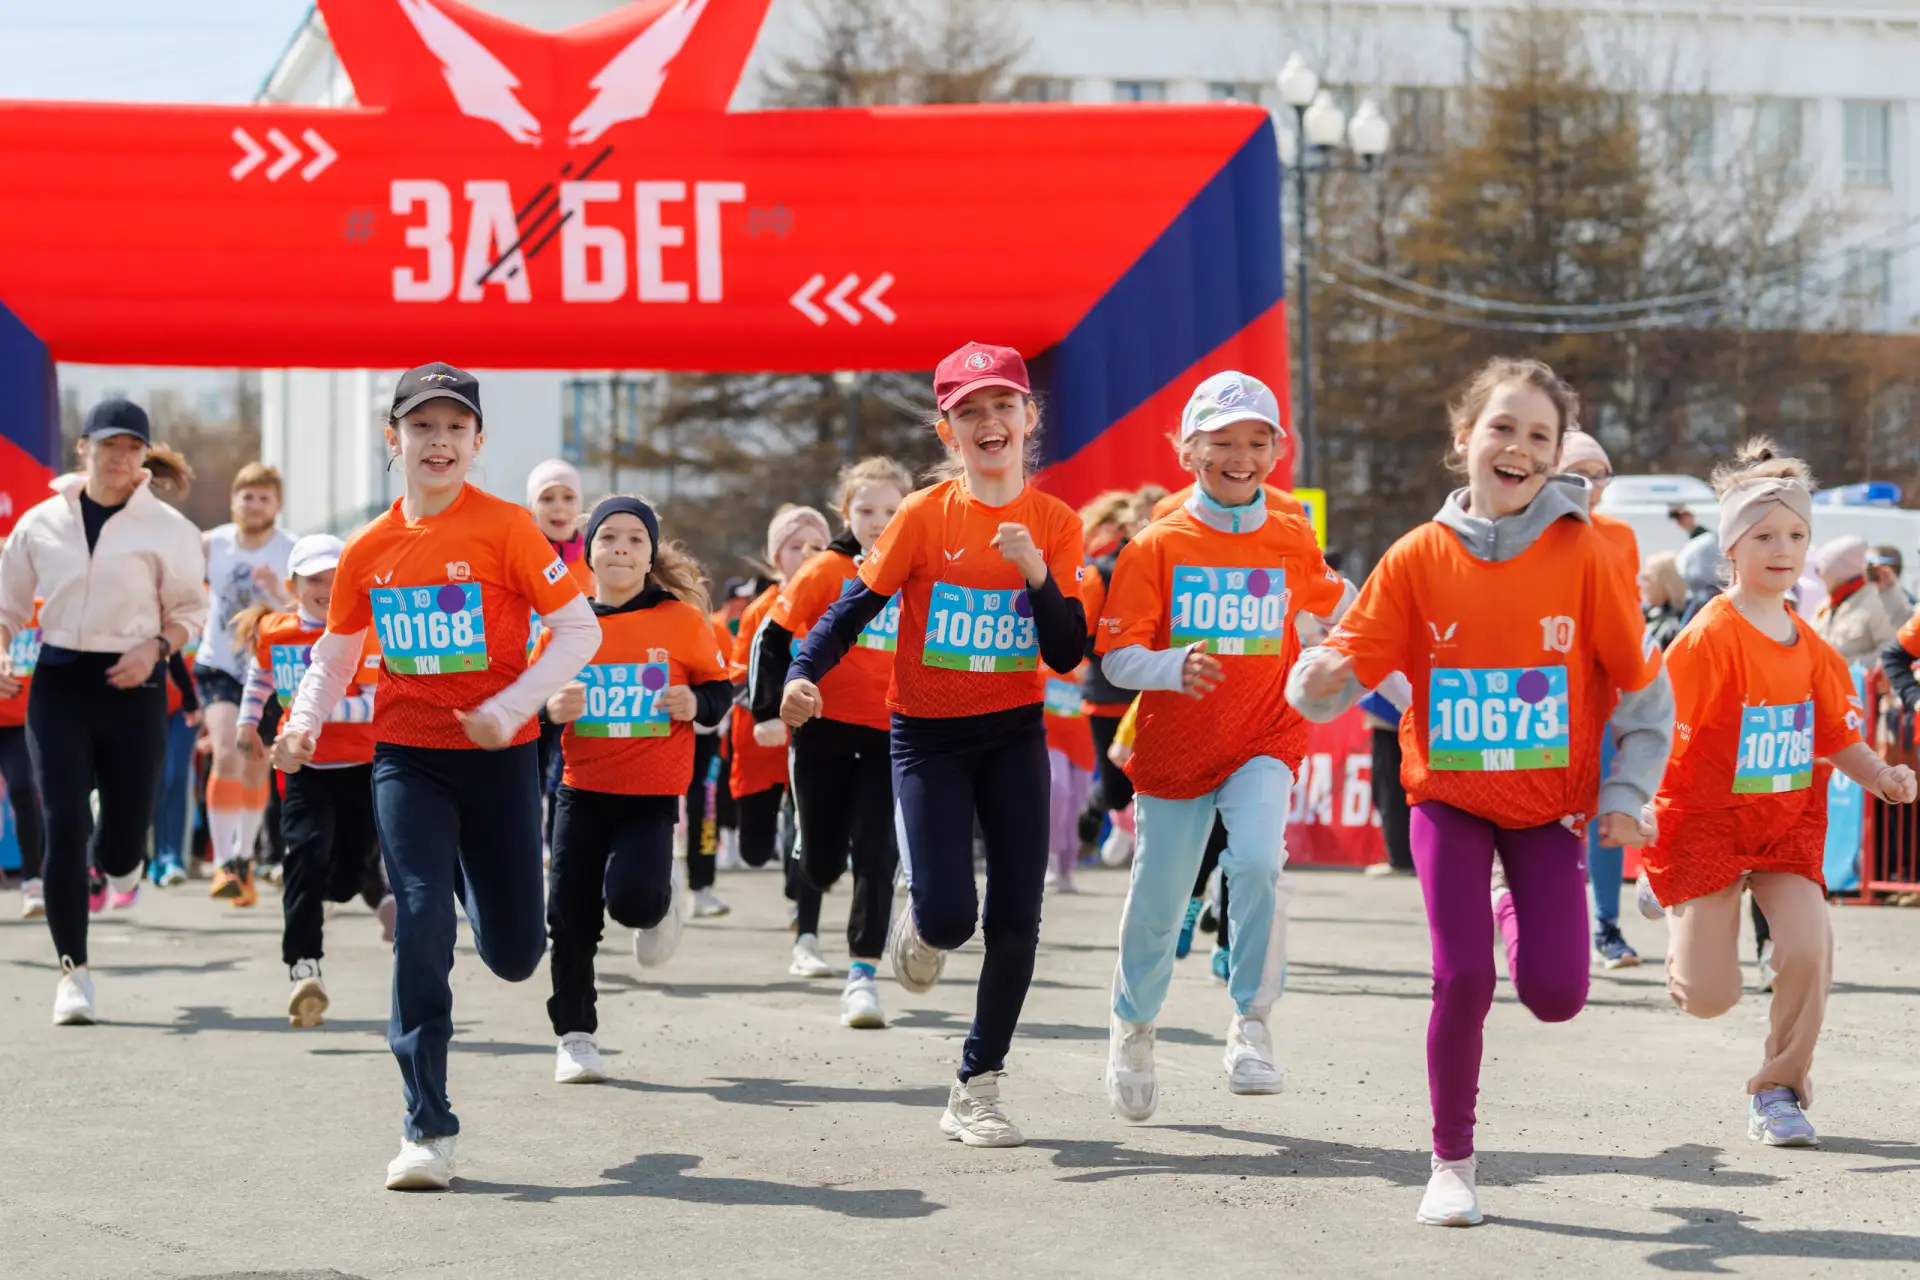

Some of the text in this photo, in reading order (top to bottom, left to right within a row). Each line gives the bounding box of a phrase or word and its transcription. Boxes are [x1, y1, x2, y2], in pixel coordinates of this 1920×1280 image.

[381, 610, 474, 650] 10168
[935, 609, 1035, 649] 10683
[1177, 592, 1280, 631] 10690
[1540, 615, 1576, 654] 10
[1437, 697, 1559, 742] 10673
[1745, 728, 1811, 769] 10785
